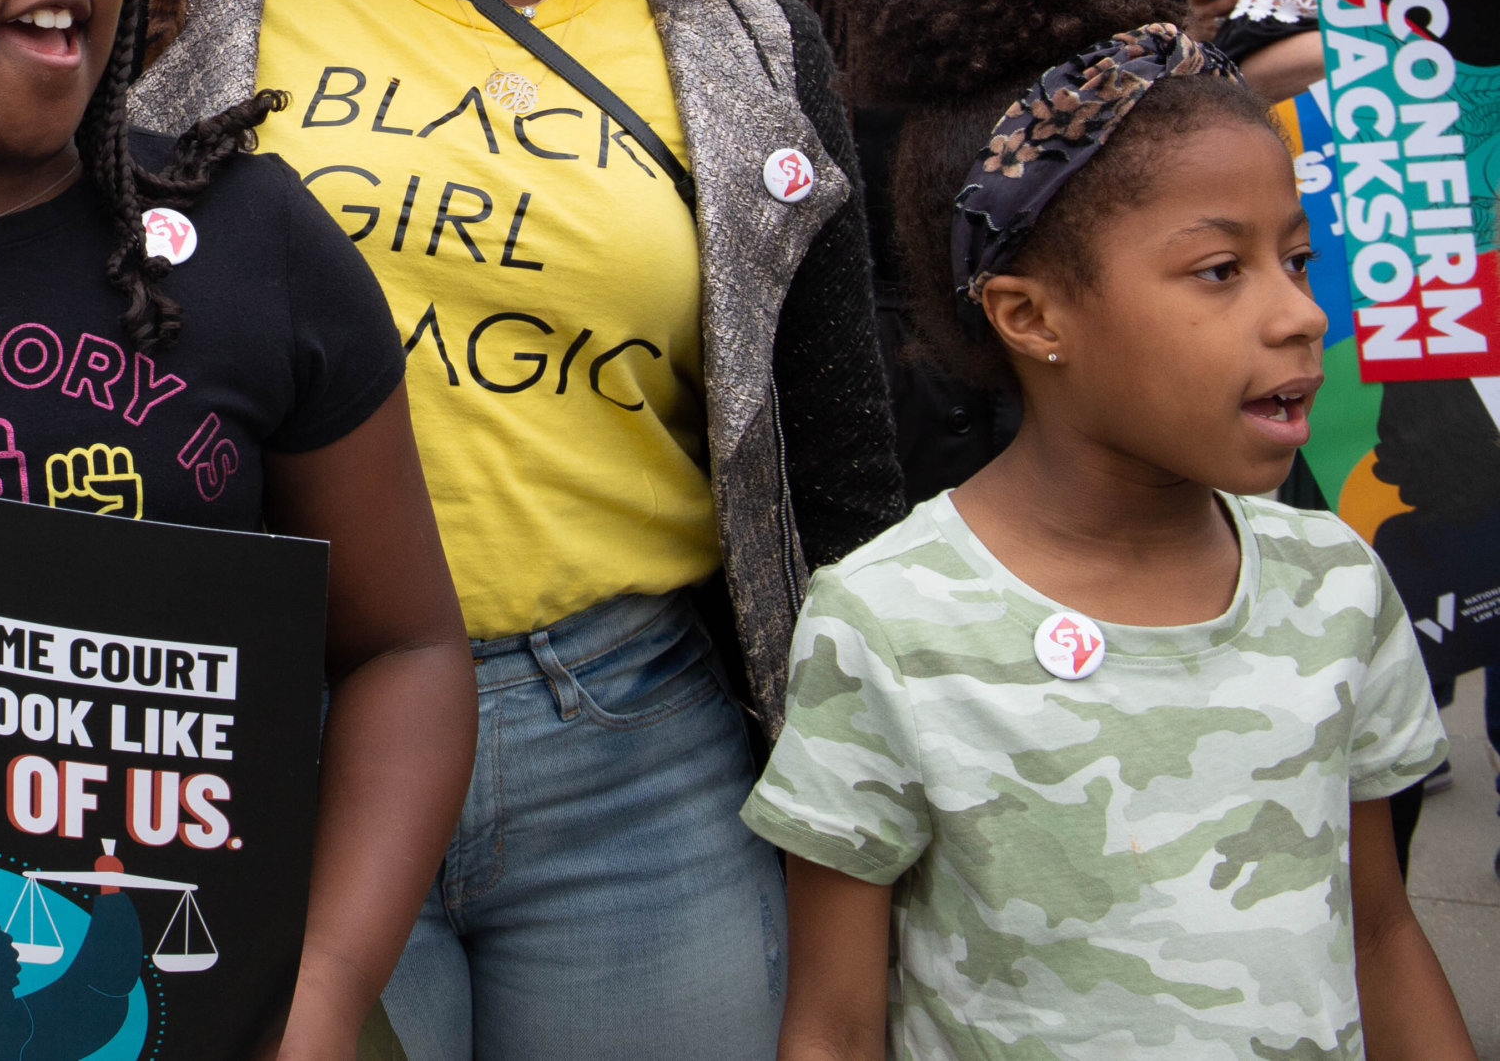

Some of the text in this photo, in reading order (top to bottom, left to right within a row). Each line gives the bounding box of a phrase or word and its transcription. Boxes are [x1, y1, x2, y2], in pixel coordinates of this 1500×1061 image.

[301, 66, 657, 179] BLACK
[300, 164, 544, 271] GIRL
[402, 302, 663, 412] AGIC
[176, 412, 239, 502] IS
[69, 638, 229, 693] COURT
[110, 704, 235, 761] LIKE
[6, 753, 108, 839] OF
[125, 767, 244, 851] US.
